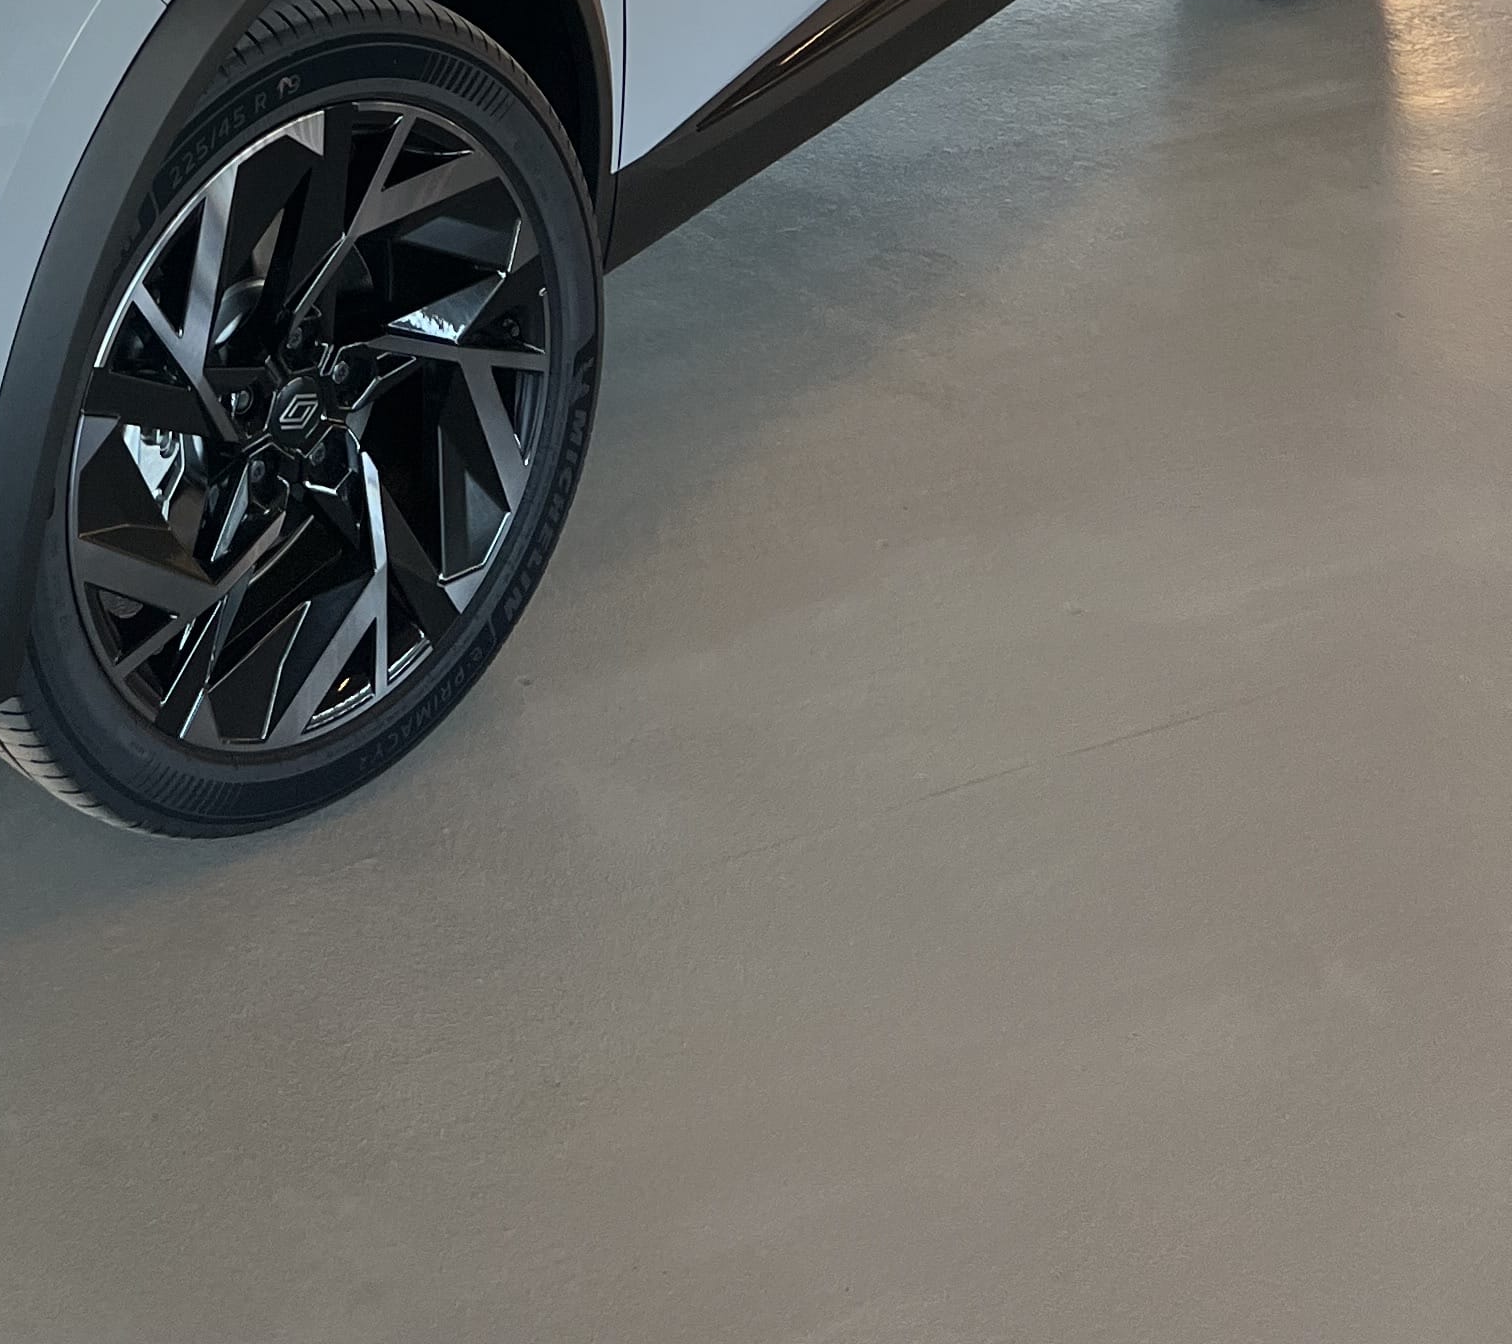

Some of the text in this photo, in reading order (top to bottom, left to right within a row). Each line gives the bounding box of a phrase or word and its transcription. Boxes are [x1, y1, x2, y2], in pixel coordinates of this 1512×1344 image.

[168, 73, 302, 188] 225/45 R 19
[502, 408, 588, 622] MICHELIN
